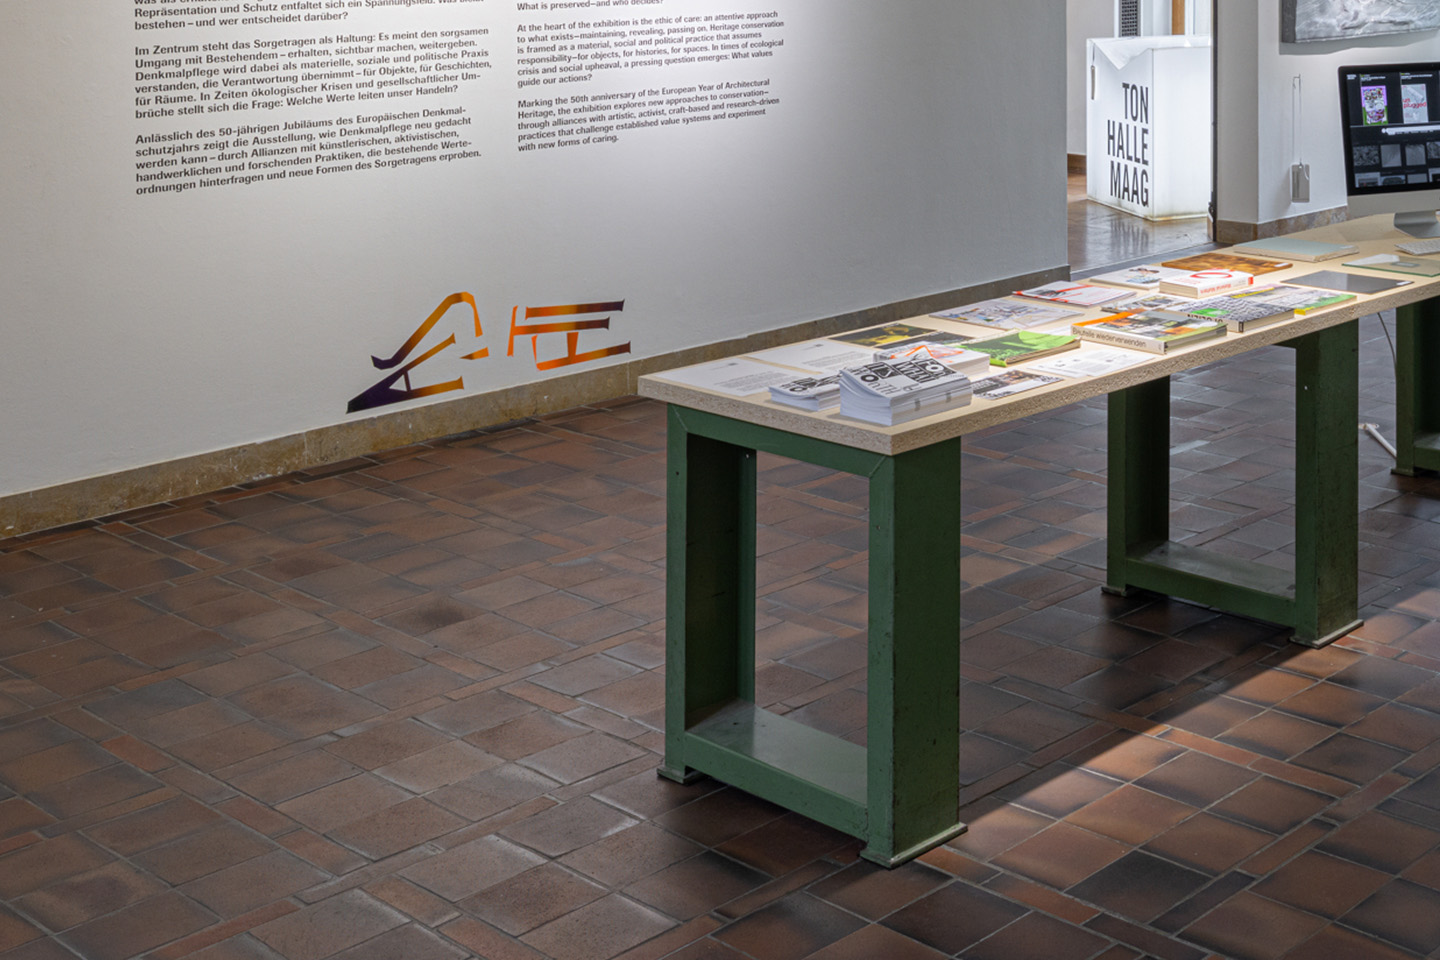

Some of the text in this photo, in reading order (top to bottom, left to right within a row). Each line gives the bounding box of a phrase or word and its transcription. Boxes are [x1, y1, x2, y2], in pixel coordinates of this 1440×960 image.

[135, 28, 489, 55] Im Zentrum steht das Sorgetragen als Haltung: Es meint den sorgsamen
[517, 73, 593, 89] guide our actions?
[135, 84, 459, 118] brüche stellt sich die Frage: Welche Werte leiten unser Handeln?
[558, 107, 572, 116] the
[573, 103, 612, 115] exhibition
[613, 100, 647, 112] explores
[648, 99, 665, 107] new
[665, 94, 709, 107] approaches
[710, 93, 718, 101] to
[1122, 82, 1149, 125] TON
[136, 117, 472, 158] schutzjahrs zeigt die Ausstellung, wie Denkmalpflege neu gedacht
[518, 142, 537, 152] with
[538, 141, 556, 150] new
[557, 138, 581, 148] forms
[582, 136, 591, 145] of
[1107, 119, 1149, 166] HALLE
[136, 149, 482, 196] ordnungen hinterfragen und neue Formen des Sorgetragens erproben.
[1110, 160, 1149, 208] MAAG
